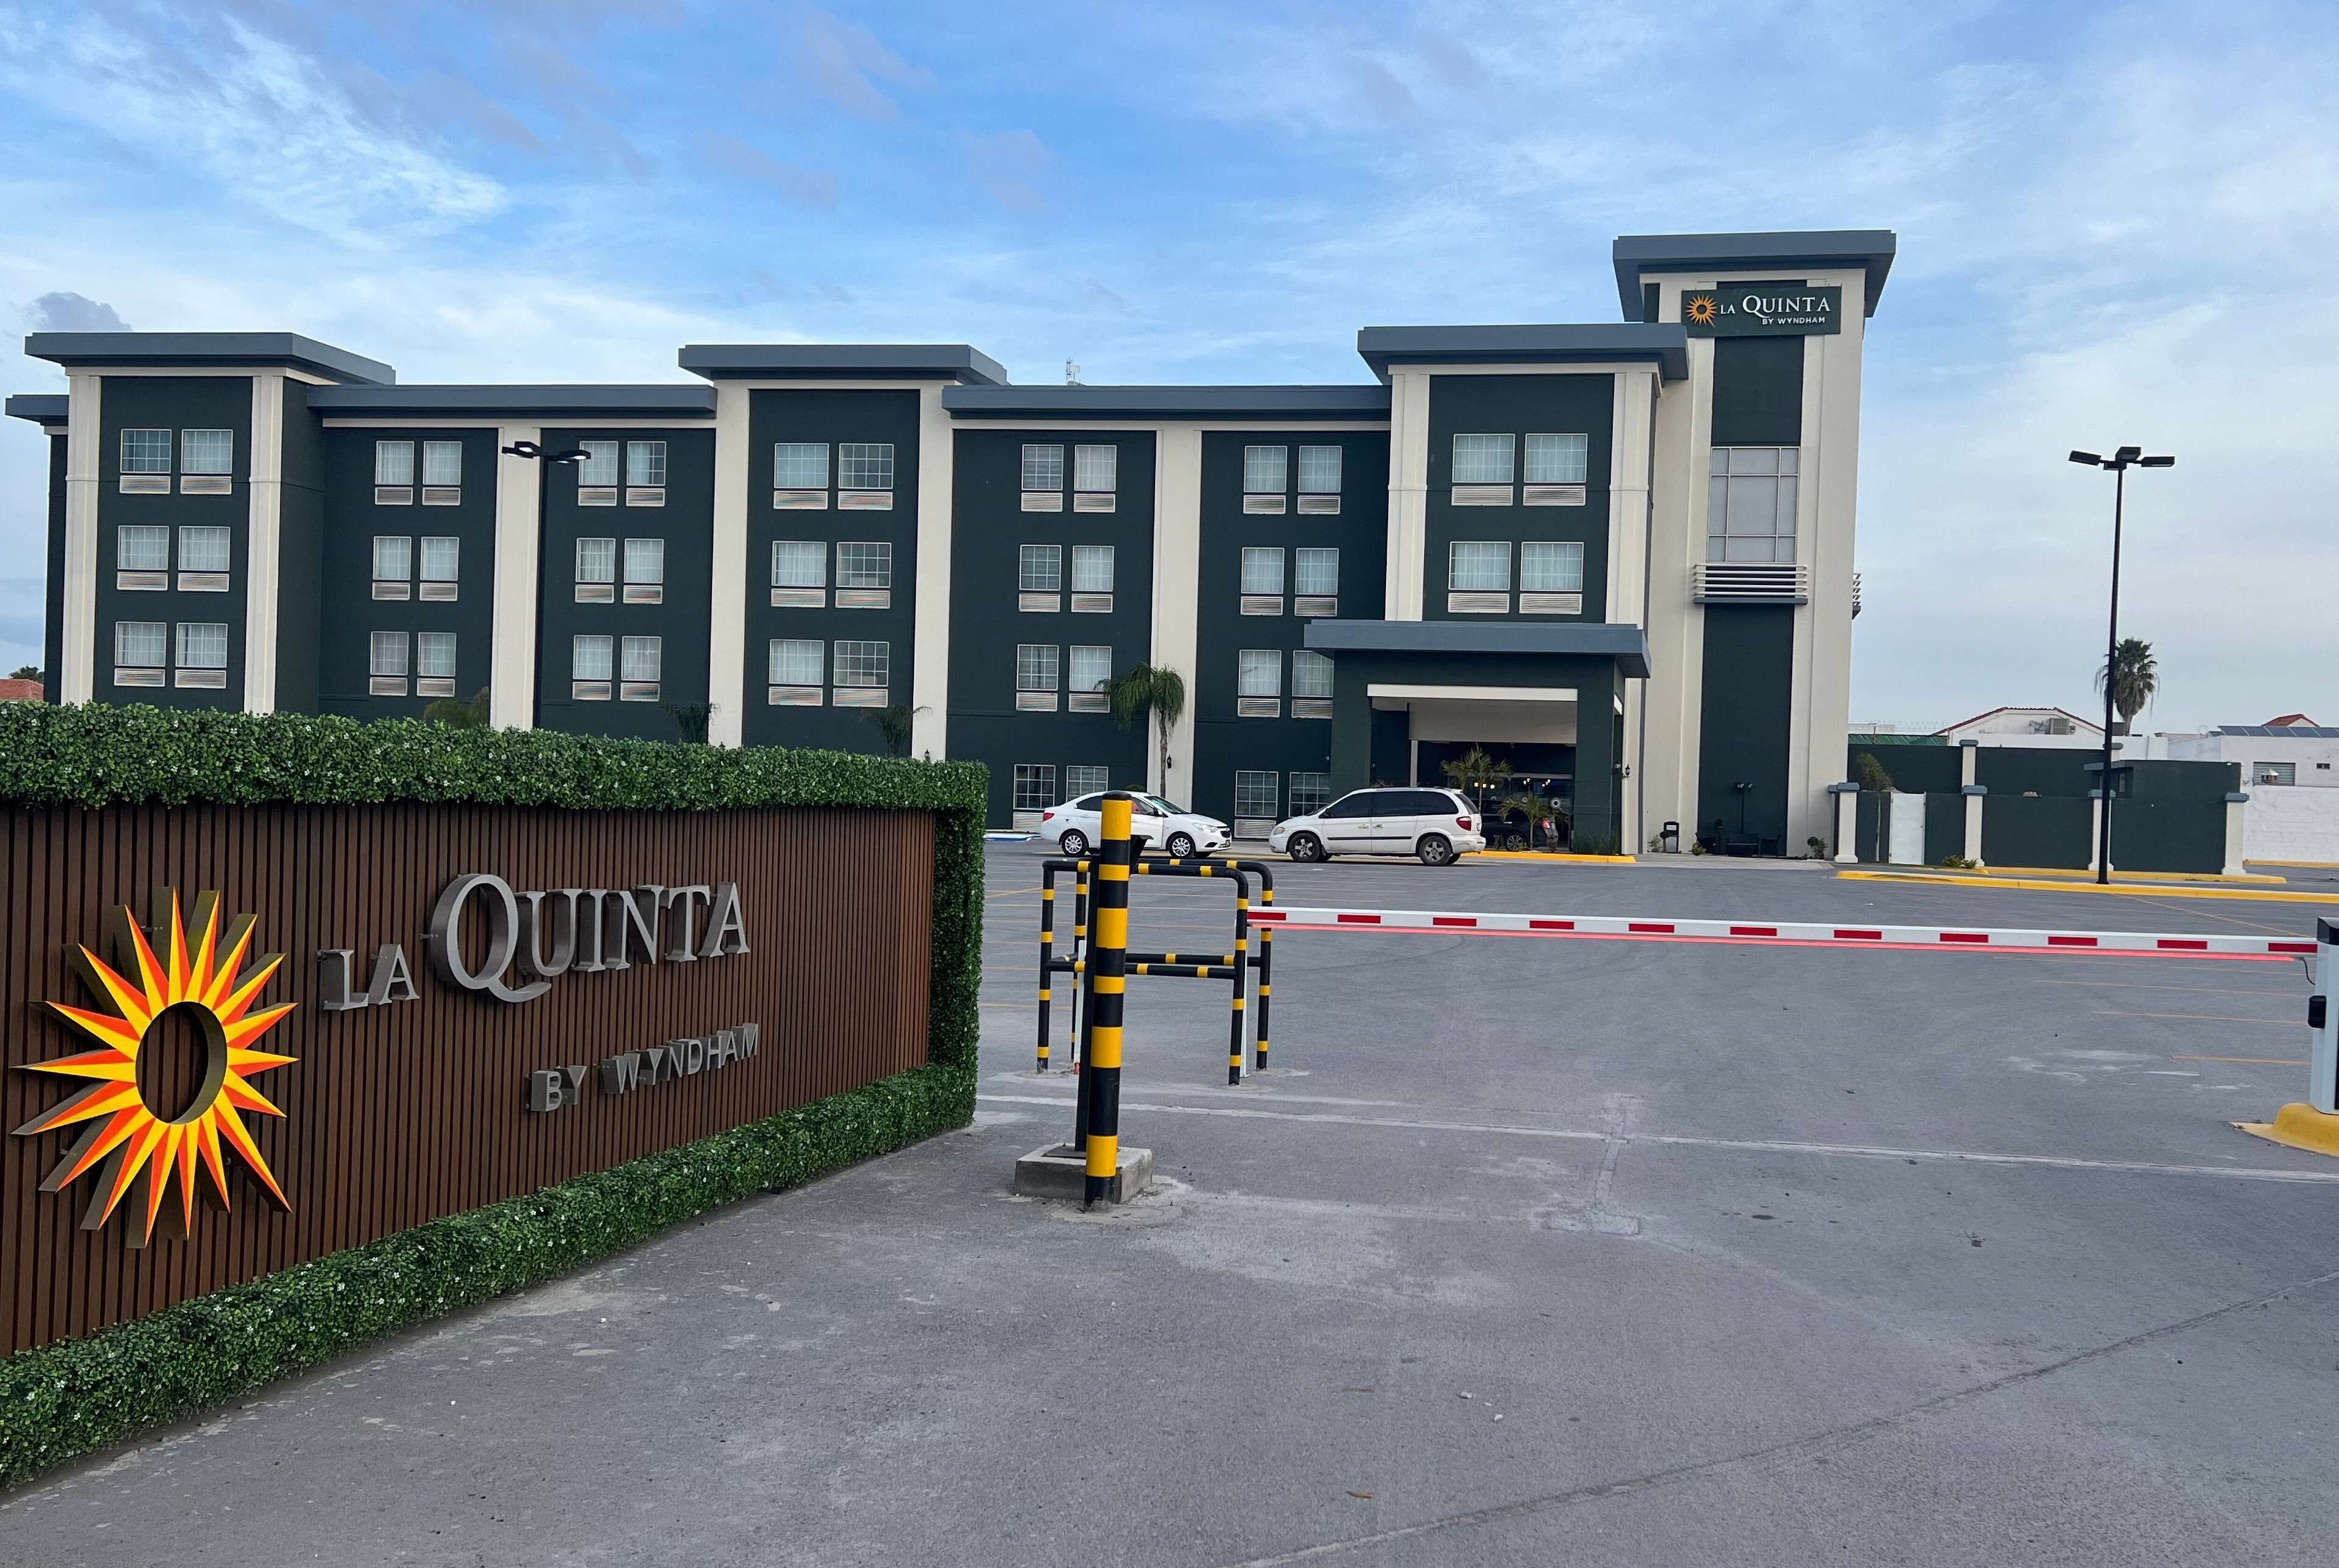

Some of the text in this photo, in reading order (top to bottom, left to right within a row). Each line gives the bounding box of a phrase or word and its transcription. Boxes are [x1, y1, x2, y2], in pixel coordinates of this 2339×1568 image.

[1720, 295, 1831, 318] LA QUINTA
[320, 873, 750, 1011] LA QUINTA
[531, 1022, 759, 1112] BY WYNDHAM
